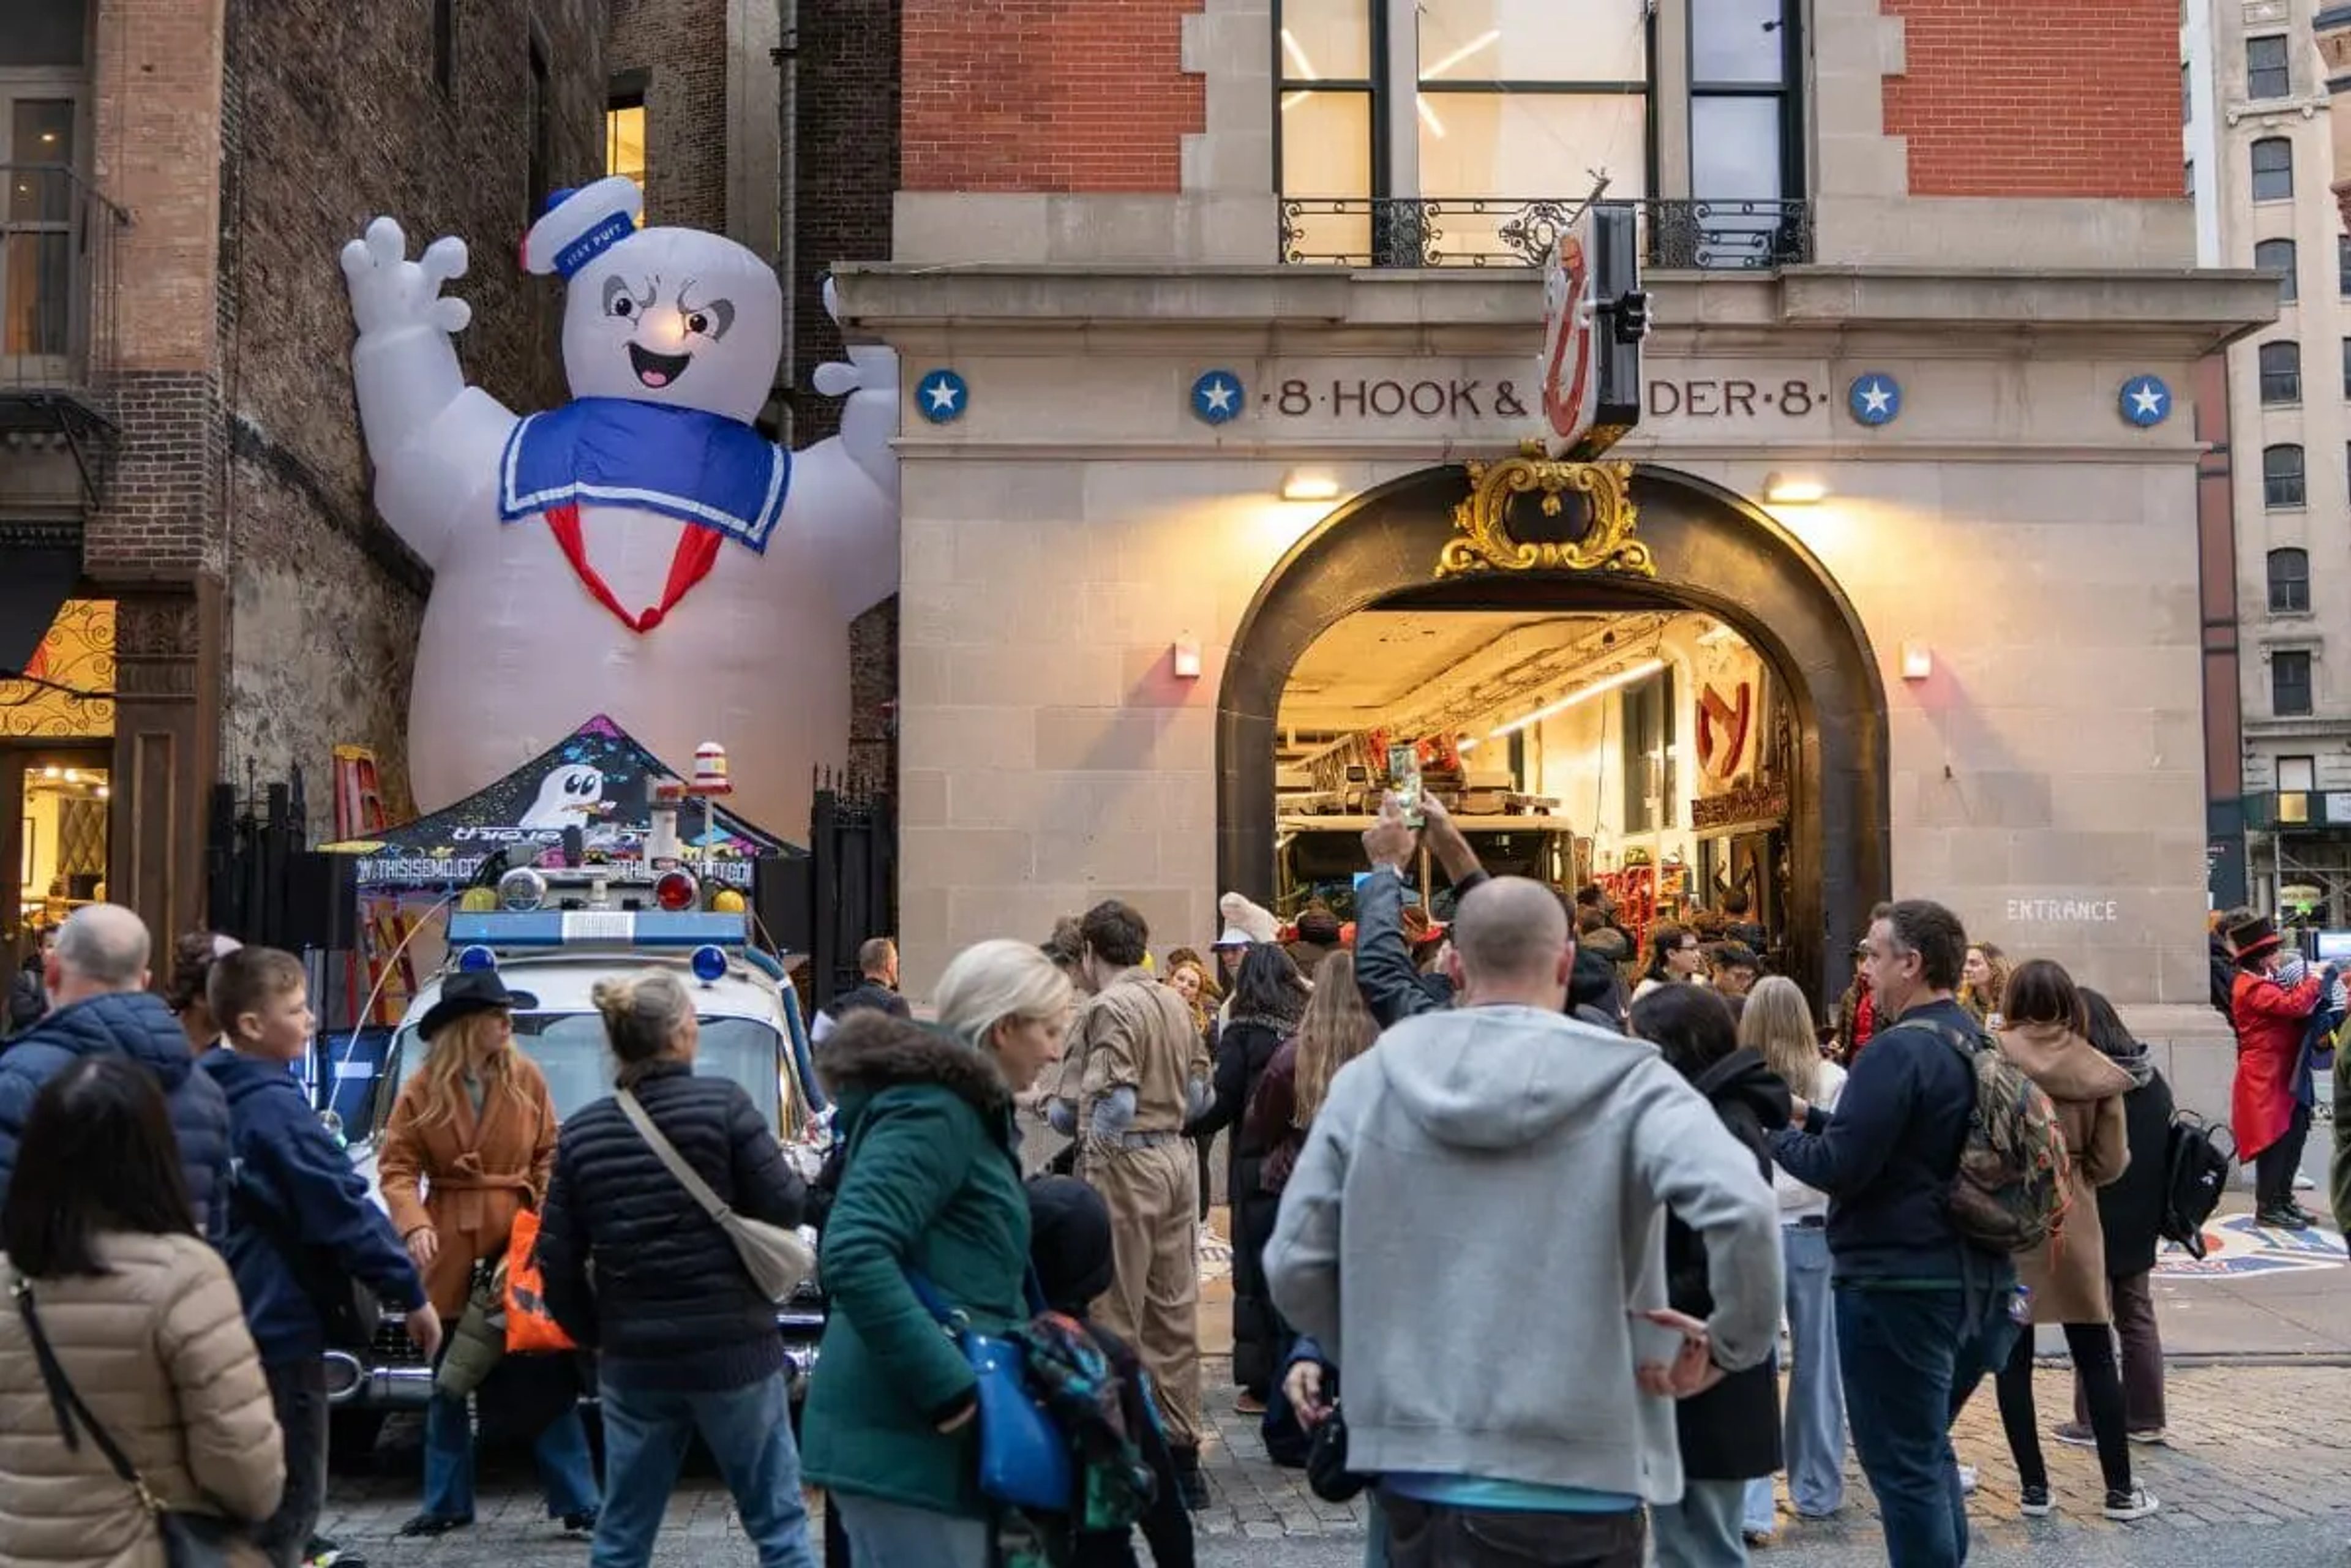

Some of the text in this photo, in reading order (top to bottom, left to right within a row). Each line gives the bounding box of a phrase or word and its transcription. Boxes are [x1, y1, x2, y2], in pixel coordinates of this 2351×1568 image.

[1333, 380, 1480, 417] HOOK
[1494, 380, 1528, 416] &
[2007, 899, 2118, 920] ENTRANCE
